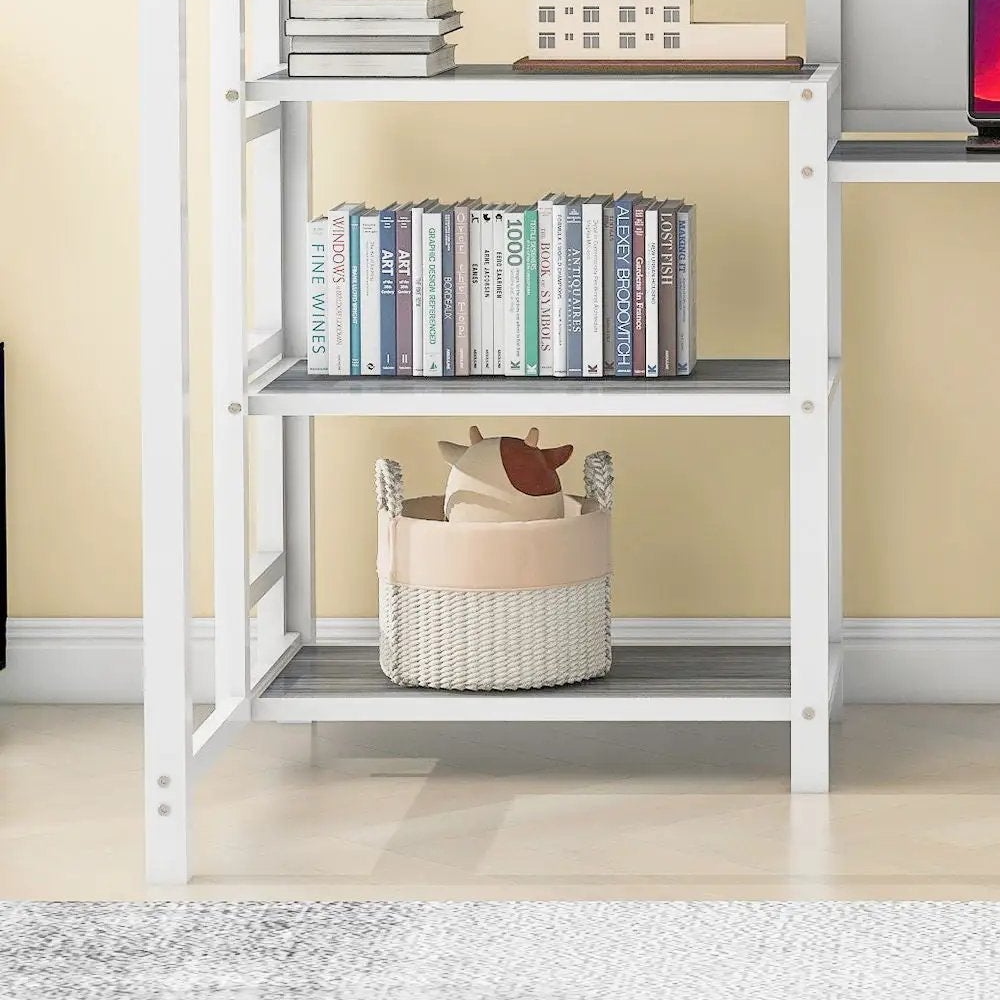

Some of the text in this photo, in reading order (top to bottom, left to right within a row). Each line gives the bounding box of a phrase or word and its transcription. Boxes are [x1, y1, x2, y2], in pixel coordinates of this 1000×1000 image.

[332, 215, 345, 284] WINDOWS
[507, 219, 523, 267] 1000
[616, 205, 630, 265] ALEXEY
[661, 212, 673, 285] LOST FISH
[678, 219, 686, 261] MAKING
[311, 243, 325, 285] FINE
[381, 249, 394, 277] ART
[398, 249, 411, 277] ART
[540, 242, 551, 277] BOOK
[635, 256, 643, 290] Gardens
[678, 263, 686, 273] IT
[428, 227, 436, 345] GRAPHIC DESIGN REFERENCED
[443, 276, 453, 320] BORDEAUX
[571, 248, 581, 333] ANTIQUAIRES
[636, 292, 643, 300] in
[311, 293, 326, 354] WINES
[540, 290, 551, 352] SYMBOLS
[616, 268, 631, 365] BRODOVITCH
